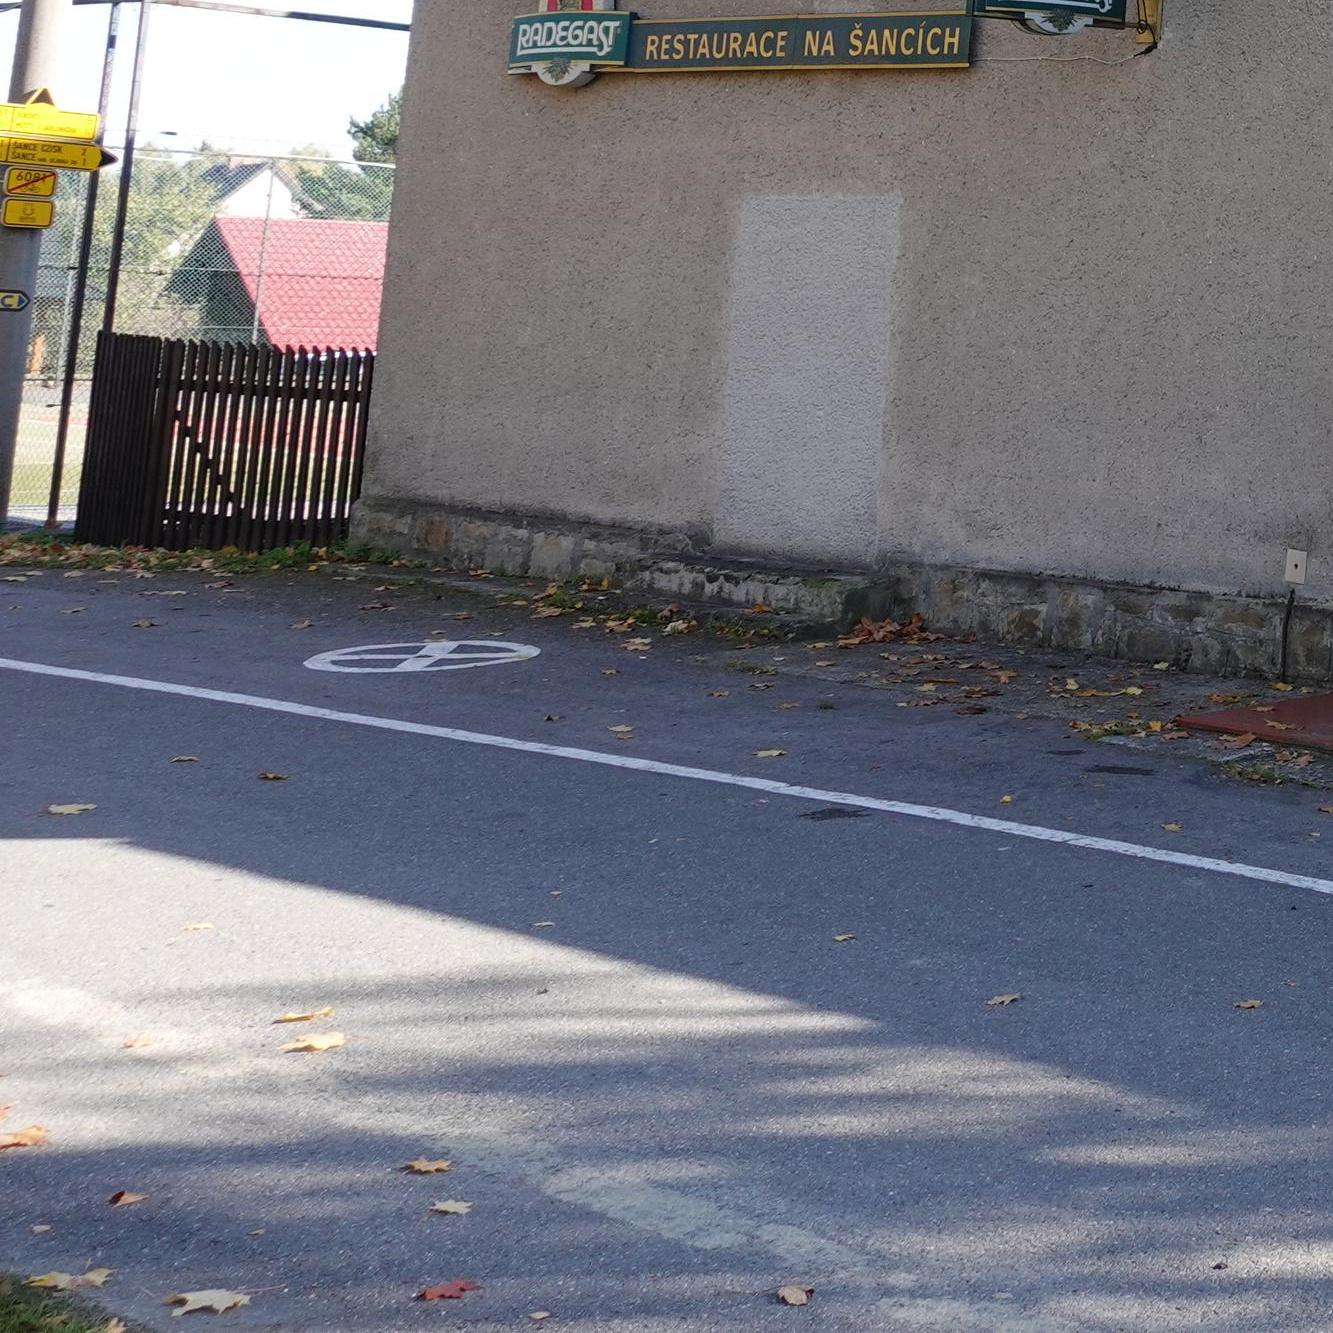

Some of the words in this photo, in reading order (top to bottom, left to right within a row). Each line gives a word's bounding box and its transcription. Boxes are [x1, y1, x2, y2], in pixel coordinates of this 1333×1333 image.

[516, 20, 622, 56] RADEGAST
[645, 31, 788, 60] RESTAURACE
[804, 29, 835, 57] NA
[848, 20, 960, 56] ŠANCÍCH
